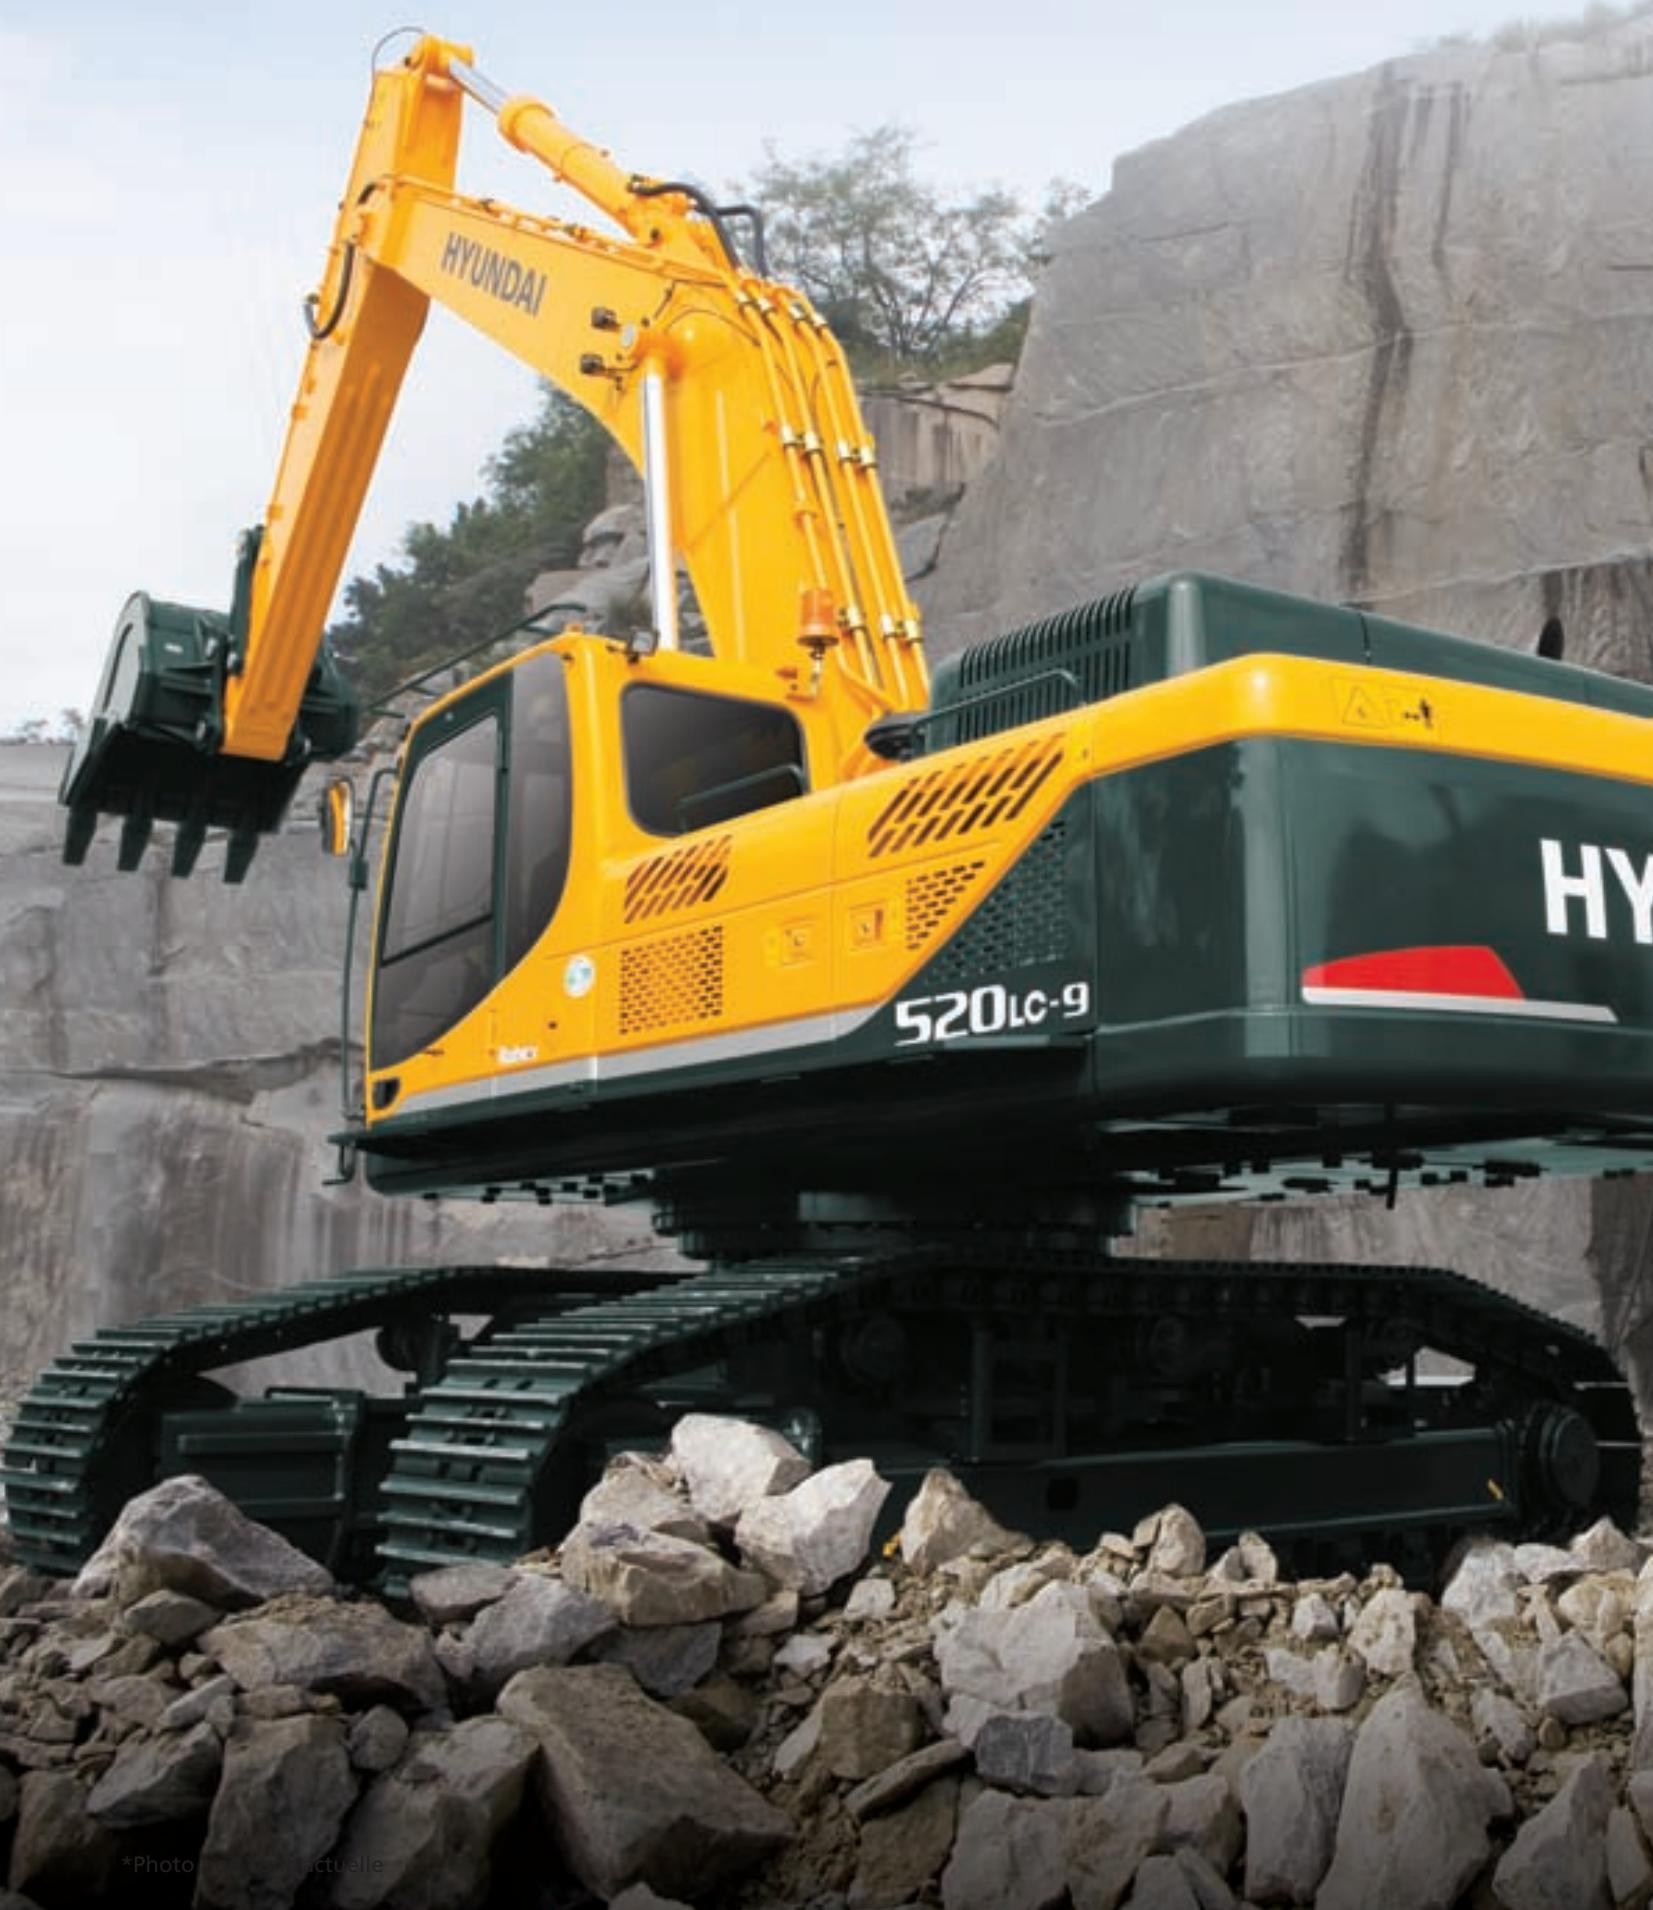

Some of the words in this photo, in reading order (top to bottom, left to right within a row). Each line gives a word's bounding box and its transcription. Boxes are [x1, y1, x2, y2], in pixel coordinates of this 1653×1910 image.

[441, 232, 547, 317] HYUNDAI
[1540, 838, 1653, 944] HY
[894, 981, 1090, 1046] 520LC-9
